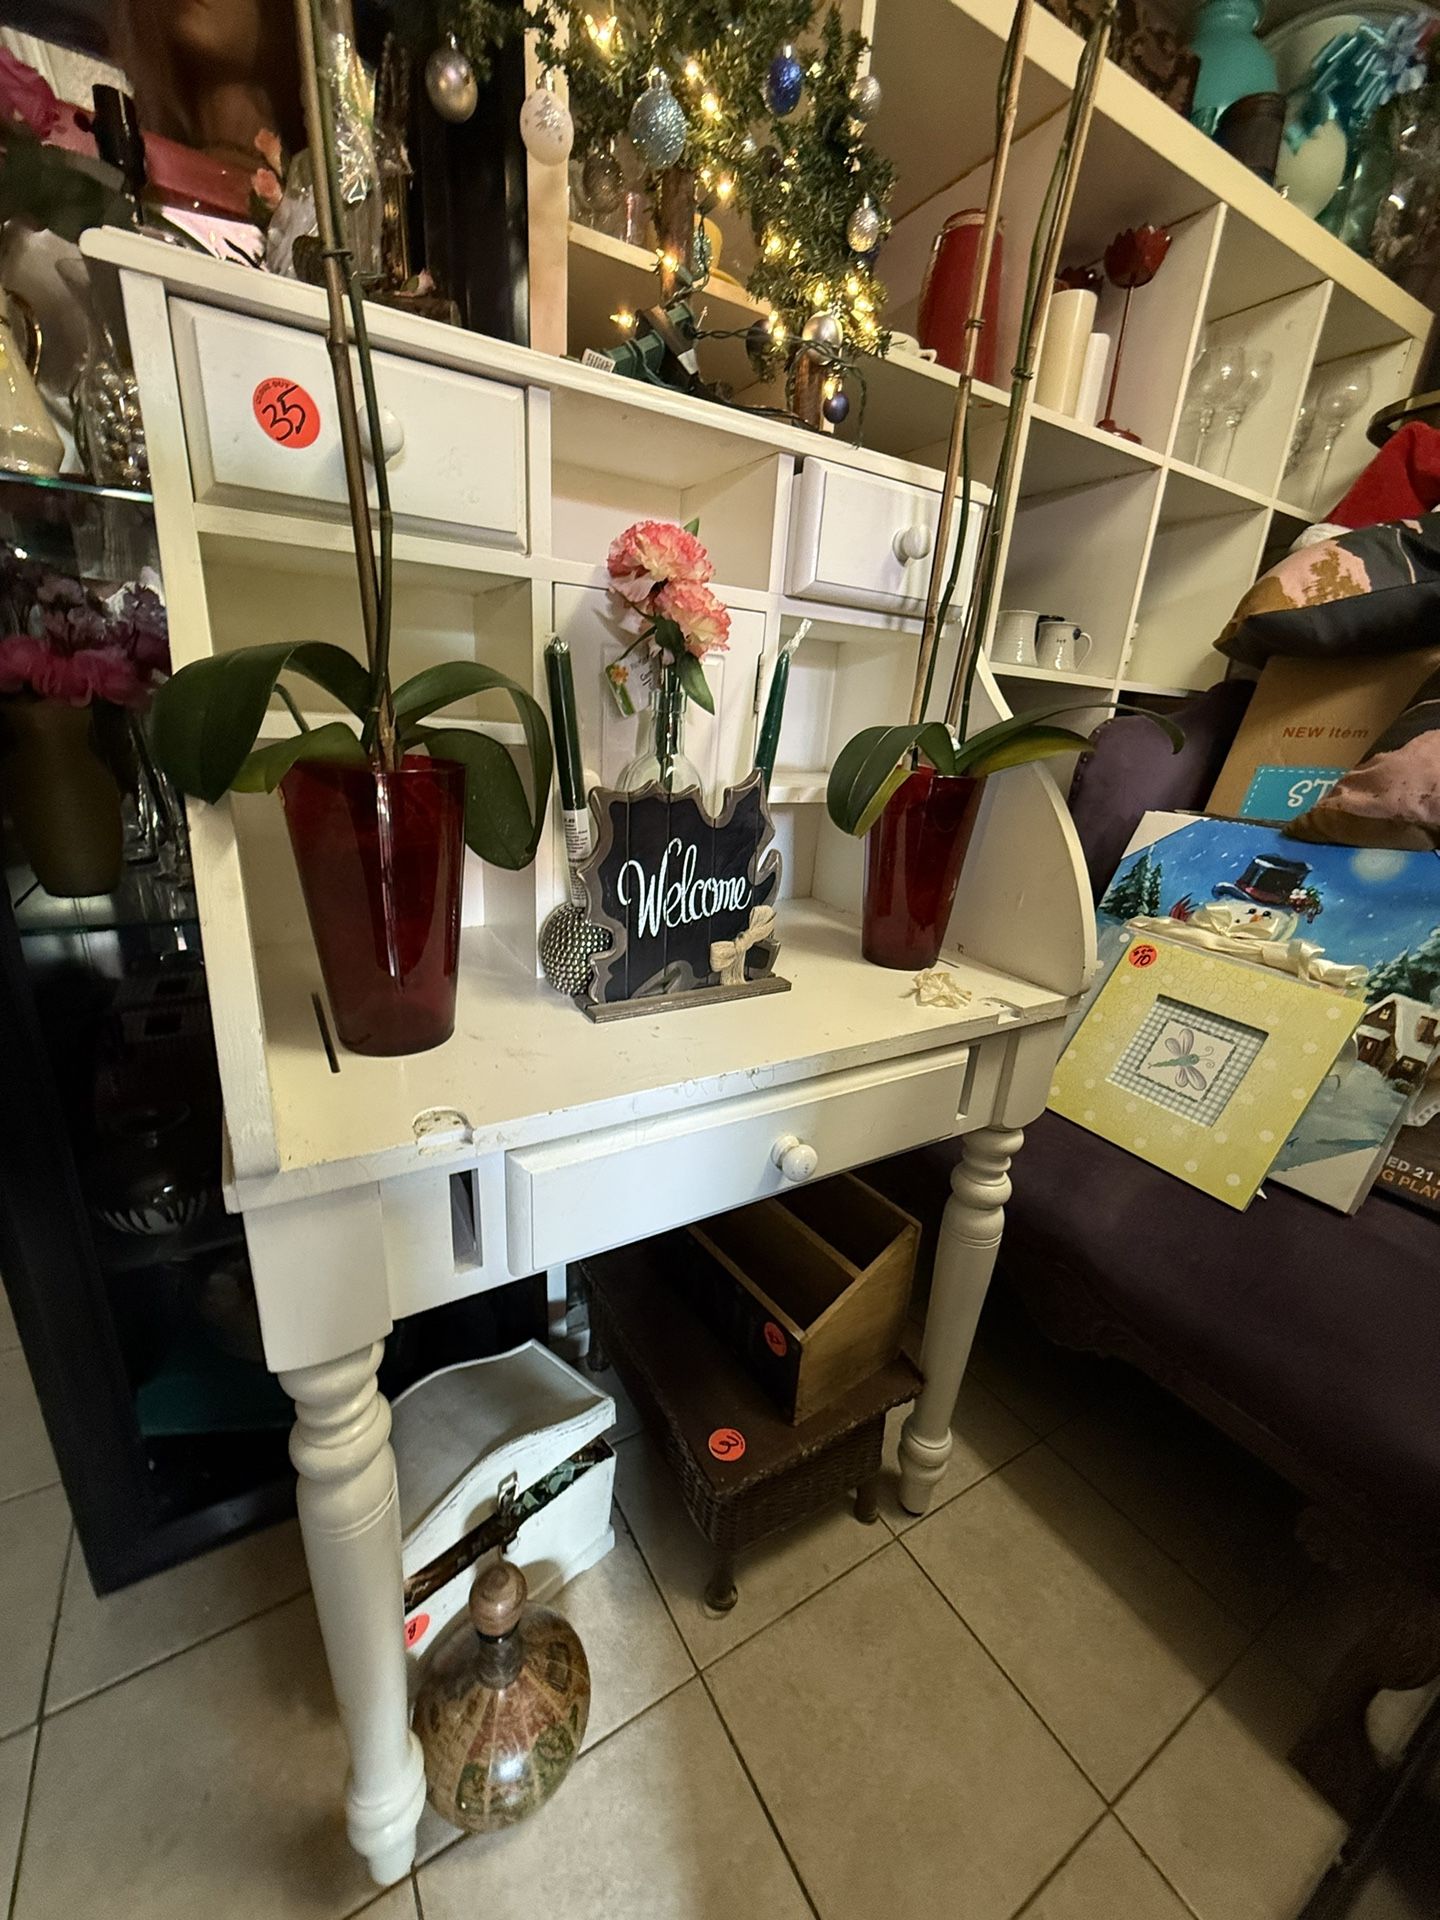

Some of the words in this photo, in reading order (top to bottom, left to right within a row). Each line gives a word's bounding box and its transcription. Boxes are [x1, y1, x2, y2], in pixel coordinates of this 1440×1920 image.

[261, 384, 306, 441] 35
[1282, 726, 1325, 738] NEW
[1328, 726, 1369, 739] Item
[617, 837, 752, 939] Welcome
[1412, 1166, 1434, 1182] 21
